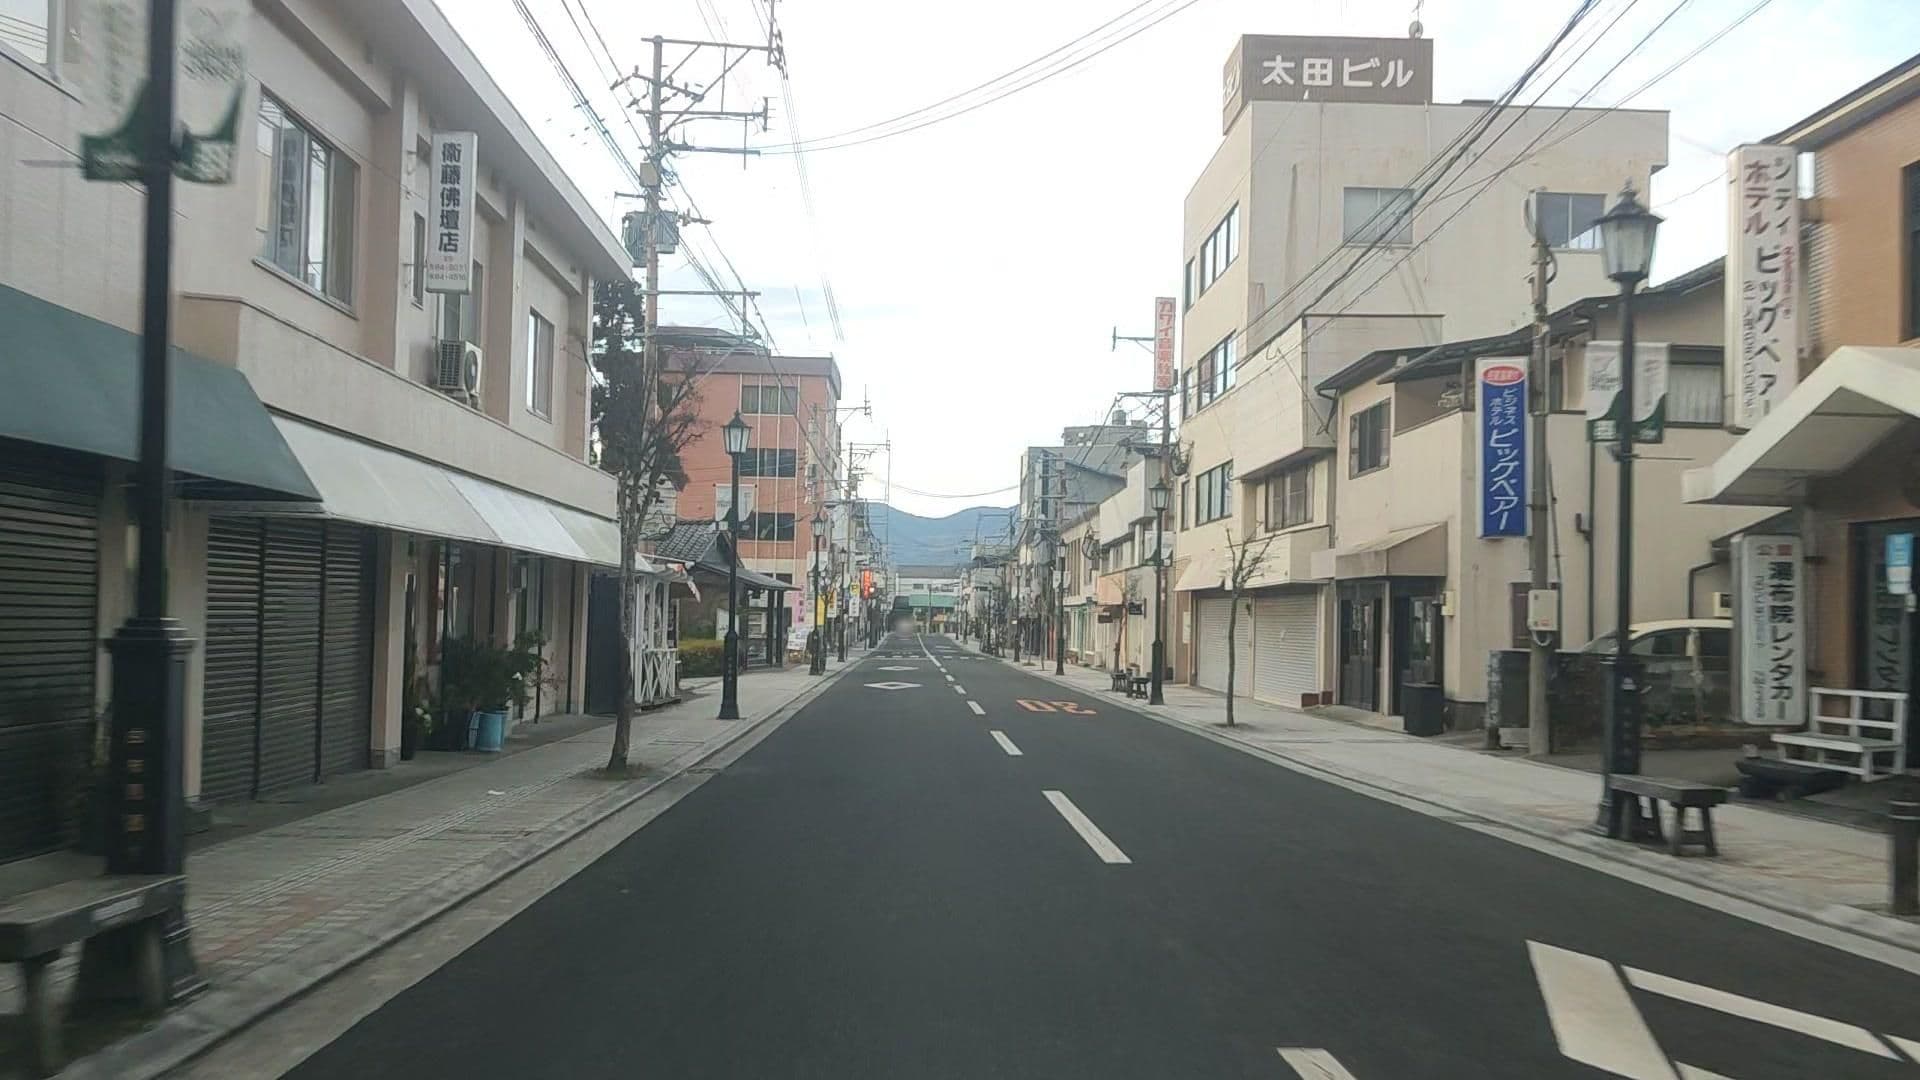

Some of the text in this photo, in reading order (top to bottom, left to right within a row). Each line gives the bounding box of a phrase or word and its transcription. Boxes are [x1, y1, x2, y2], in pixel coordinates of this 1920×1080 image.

[1261, 54, 1414, 88] 太田ビル
[438, 142, 462, 253] 衛藤佛壇店
[1743, 159, 1770, 235] ホテル
[1488, 397, 1503, 426] ホテル
[1489, 428, 1520, 530] ビッグベアー
